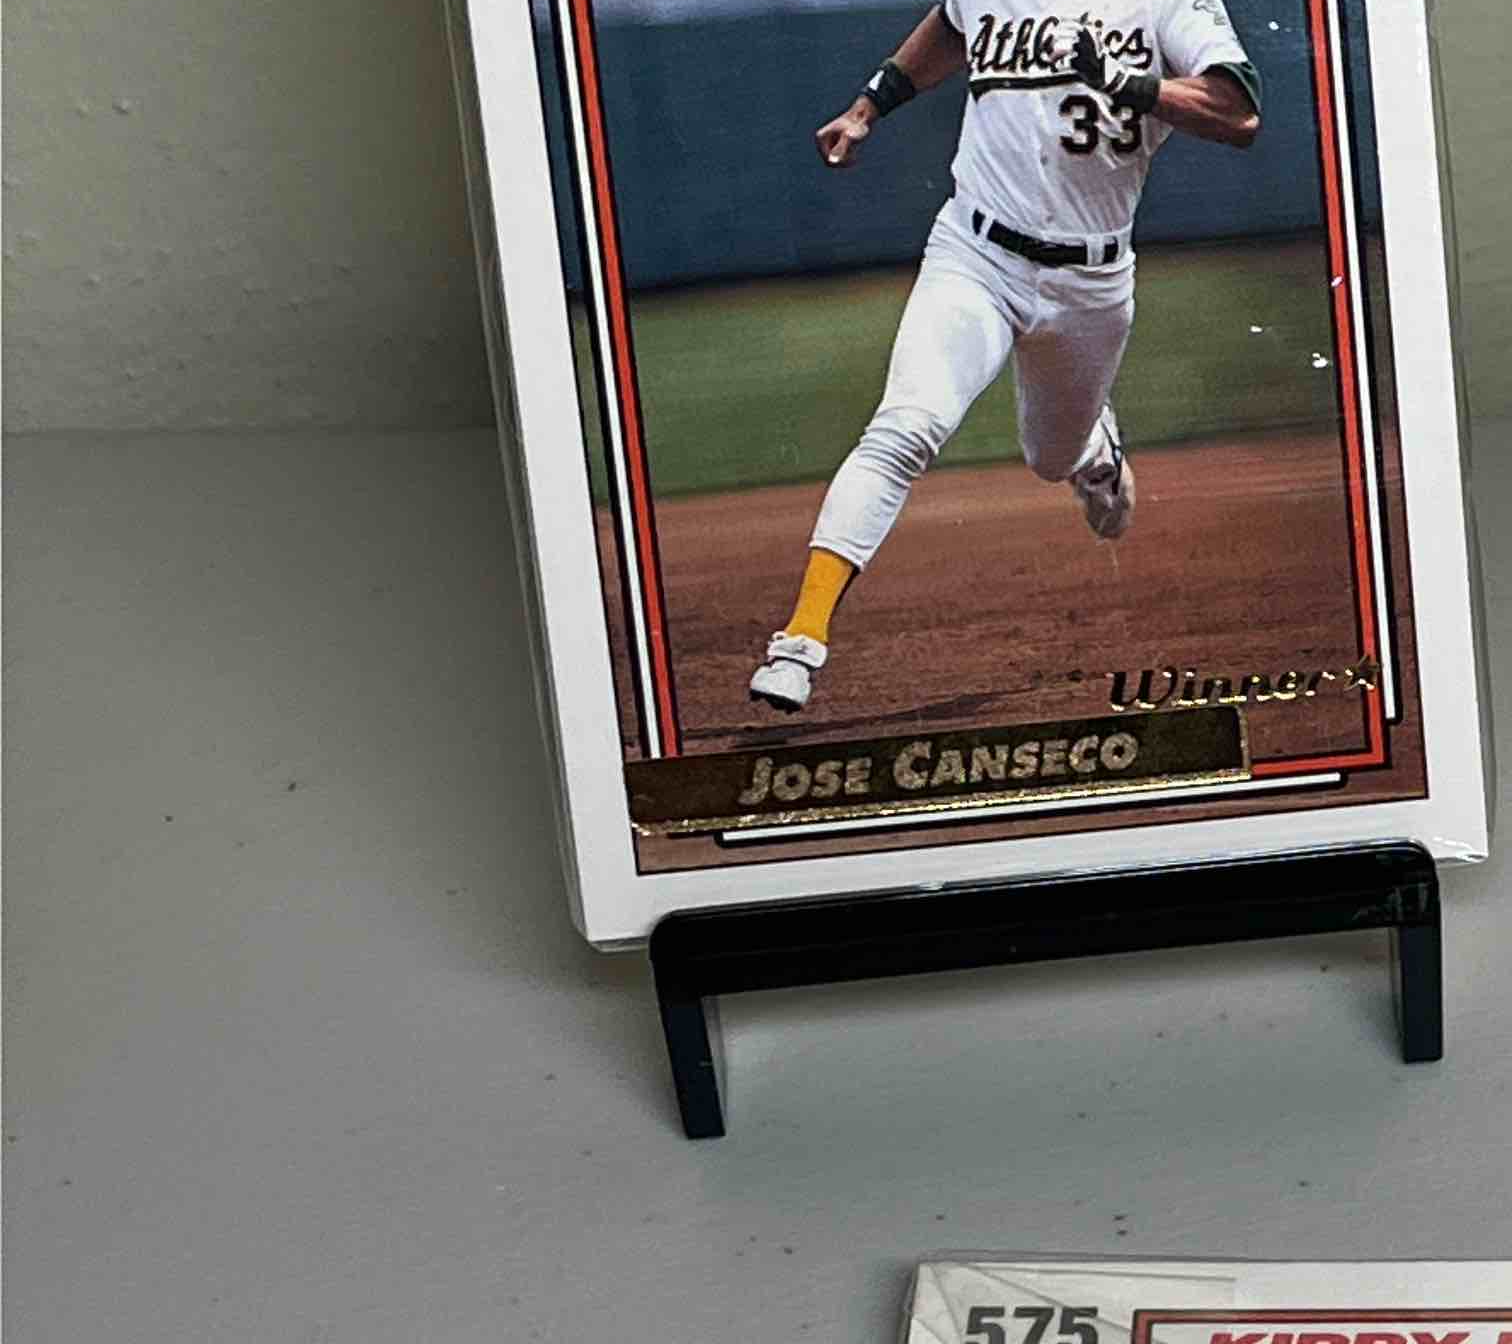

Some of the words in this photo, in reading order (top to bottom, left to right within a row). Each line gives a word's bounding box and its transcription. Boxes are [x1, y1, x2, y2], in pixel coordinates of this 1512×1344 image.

[1058, 95, 1143, 154] 33
[738, 755, 872, 806] JOSE
[892, 730, 1140, 792] CANSECO
